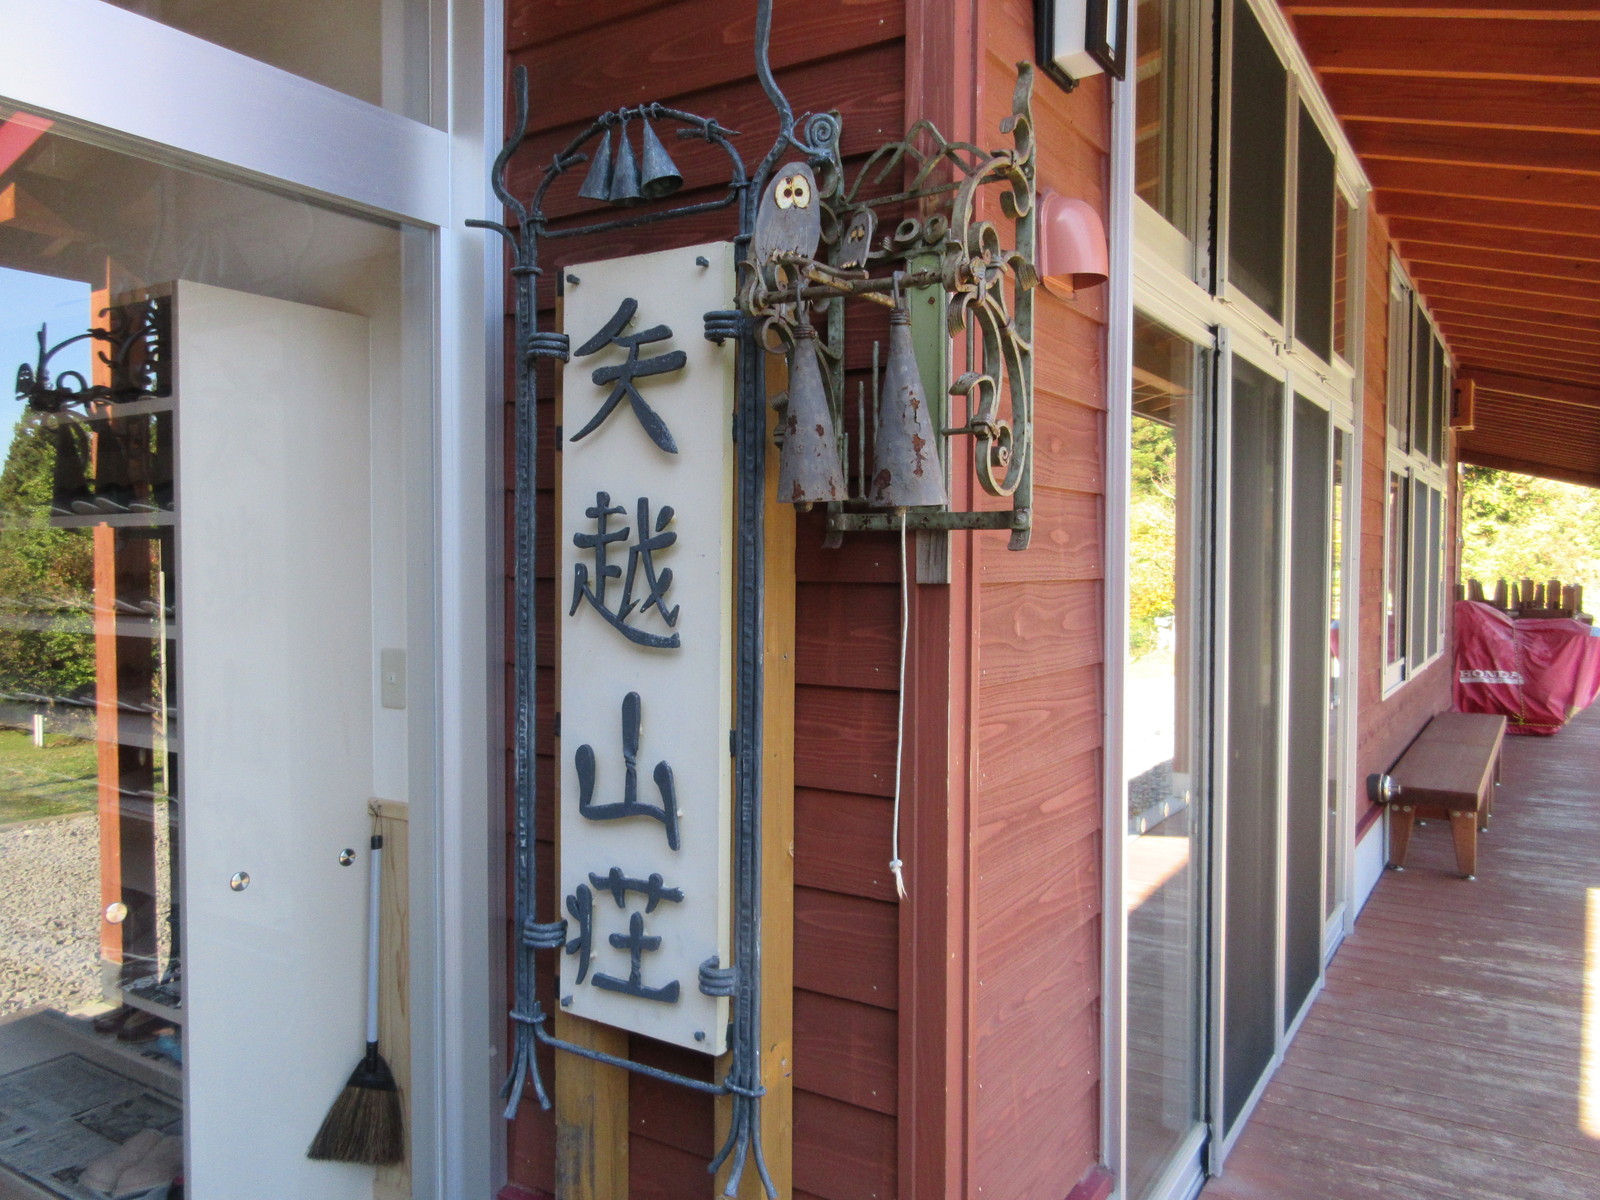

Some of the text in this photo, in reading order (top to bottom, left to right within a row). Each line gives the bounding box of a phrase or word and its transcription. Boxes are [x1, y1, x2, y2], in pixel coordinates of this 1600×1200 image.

[566, 297, 688, 1004] 矢越山荘
[1459, 669, 1522, 679] HONDA
